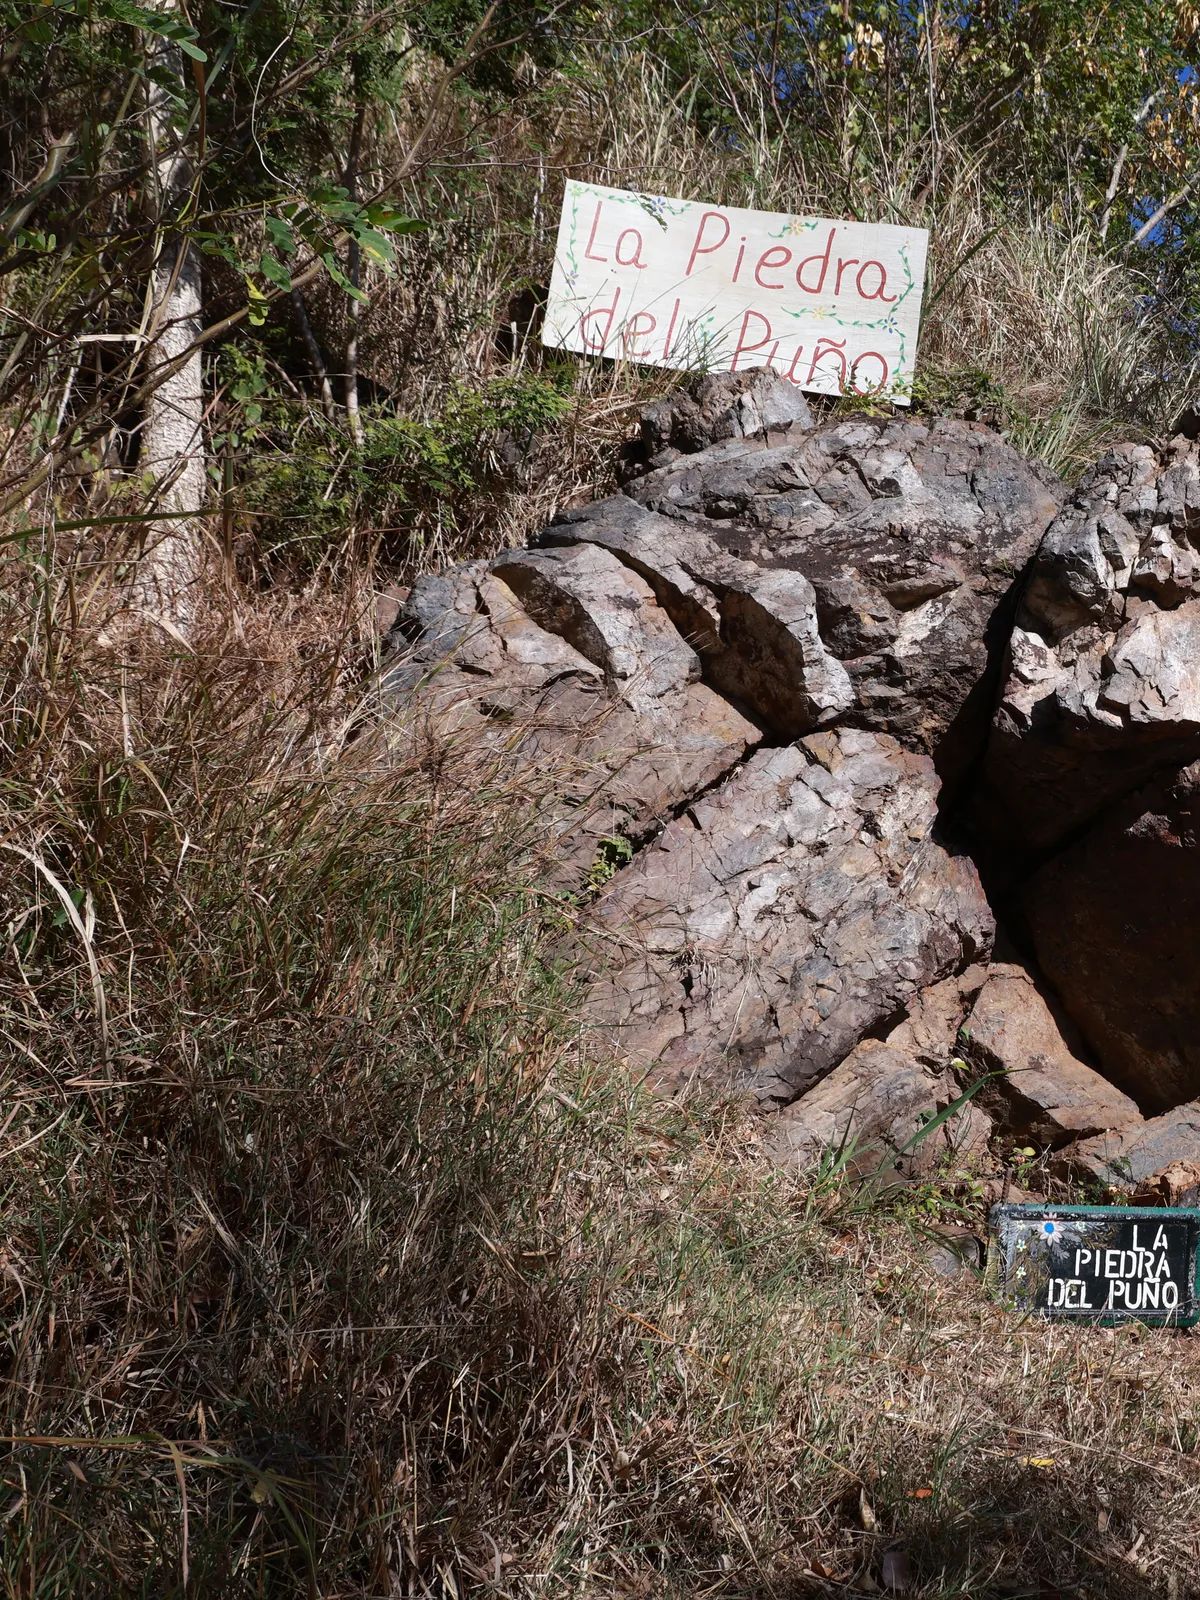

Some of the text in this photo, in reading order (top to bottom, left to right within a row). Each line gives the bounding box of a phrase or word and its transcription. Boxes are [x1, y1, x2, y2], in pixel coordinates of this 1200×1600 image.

[584, 200, 897, 302] La Piedra
[580, 287, 889, 397] del Puño
[1132, 1224, 1168, 1252] LA
[1075, 1249, 1171, 1278] PIEDRA
[1047, 1277, 1179, 1310] DEL PUÑO
